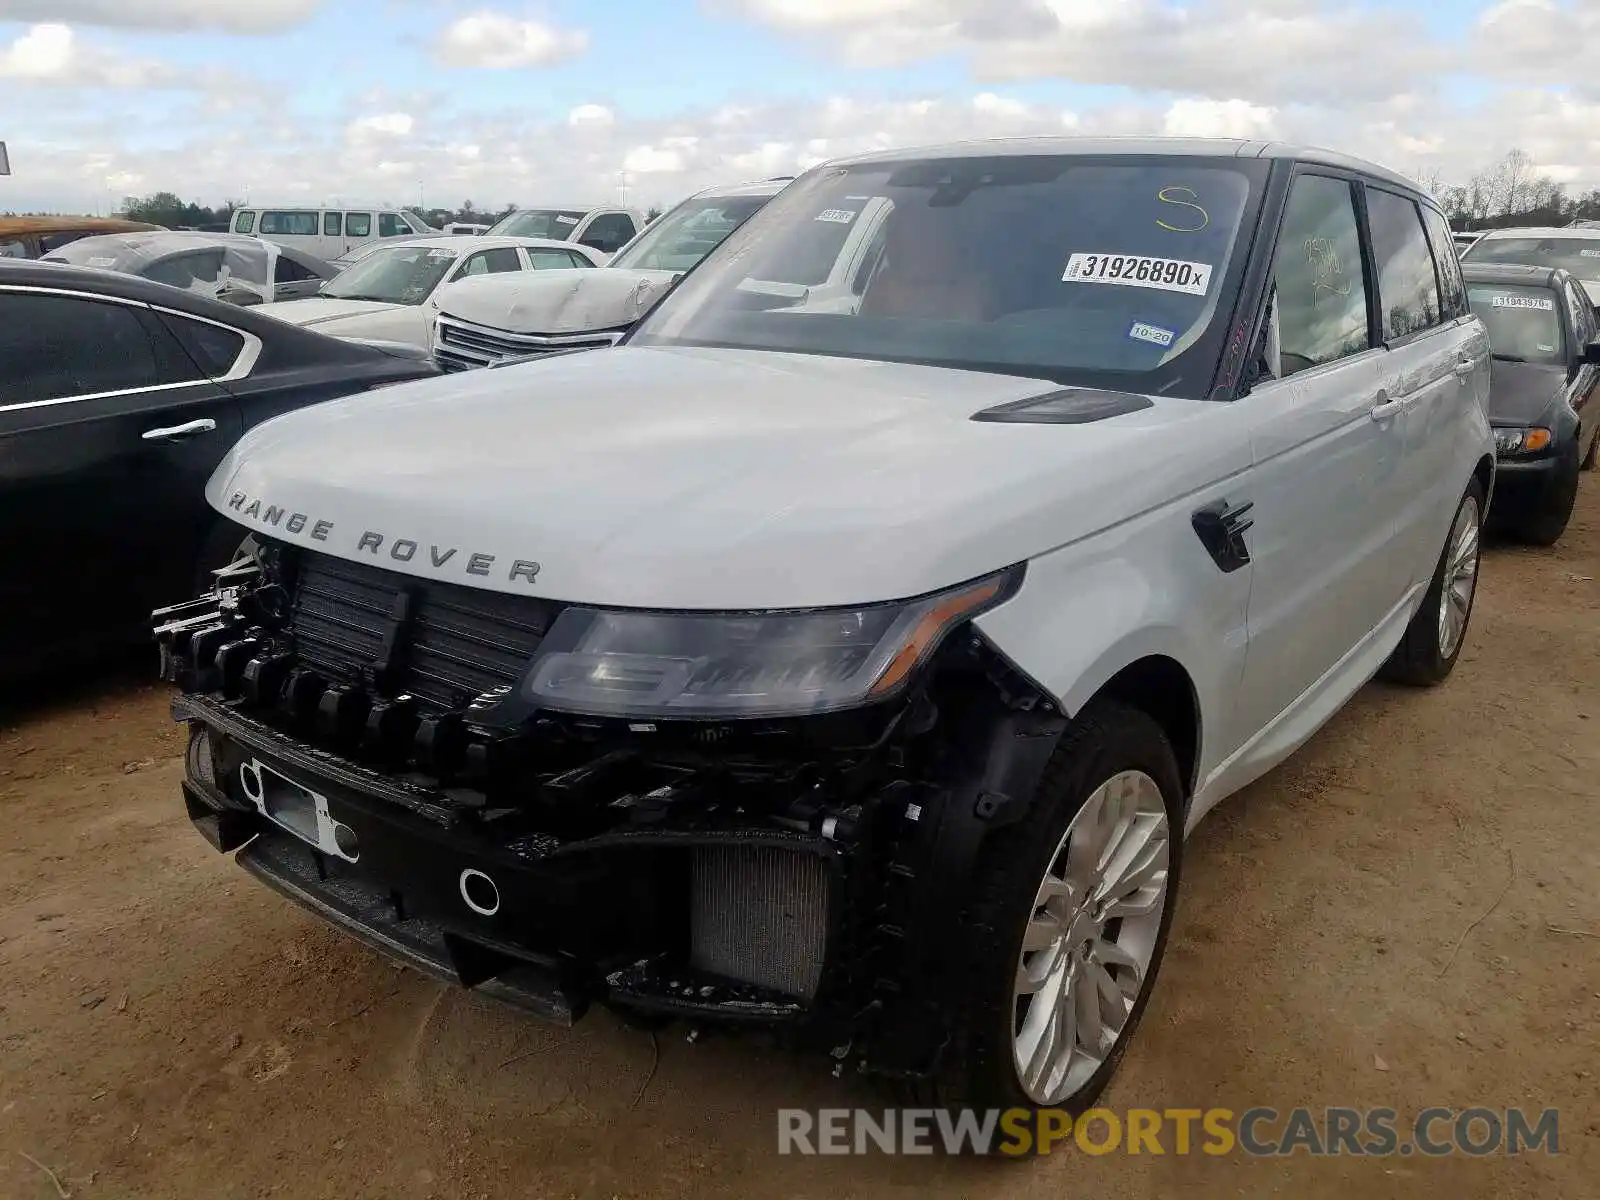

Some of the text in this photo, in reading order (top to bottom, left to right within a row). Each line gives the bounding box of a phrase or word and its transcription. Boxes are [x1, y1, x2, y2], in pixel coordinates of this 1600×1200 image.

[1156, 186, 1209, 231] S
[1134, 326, 1170, 343] 10-20
[228, 490, 544, 584] RANGE ROVER
